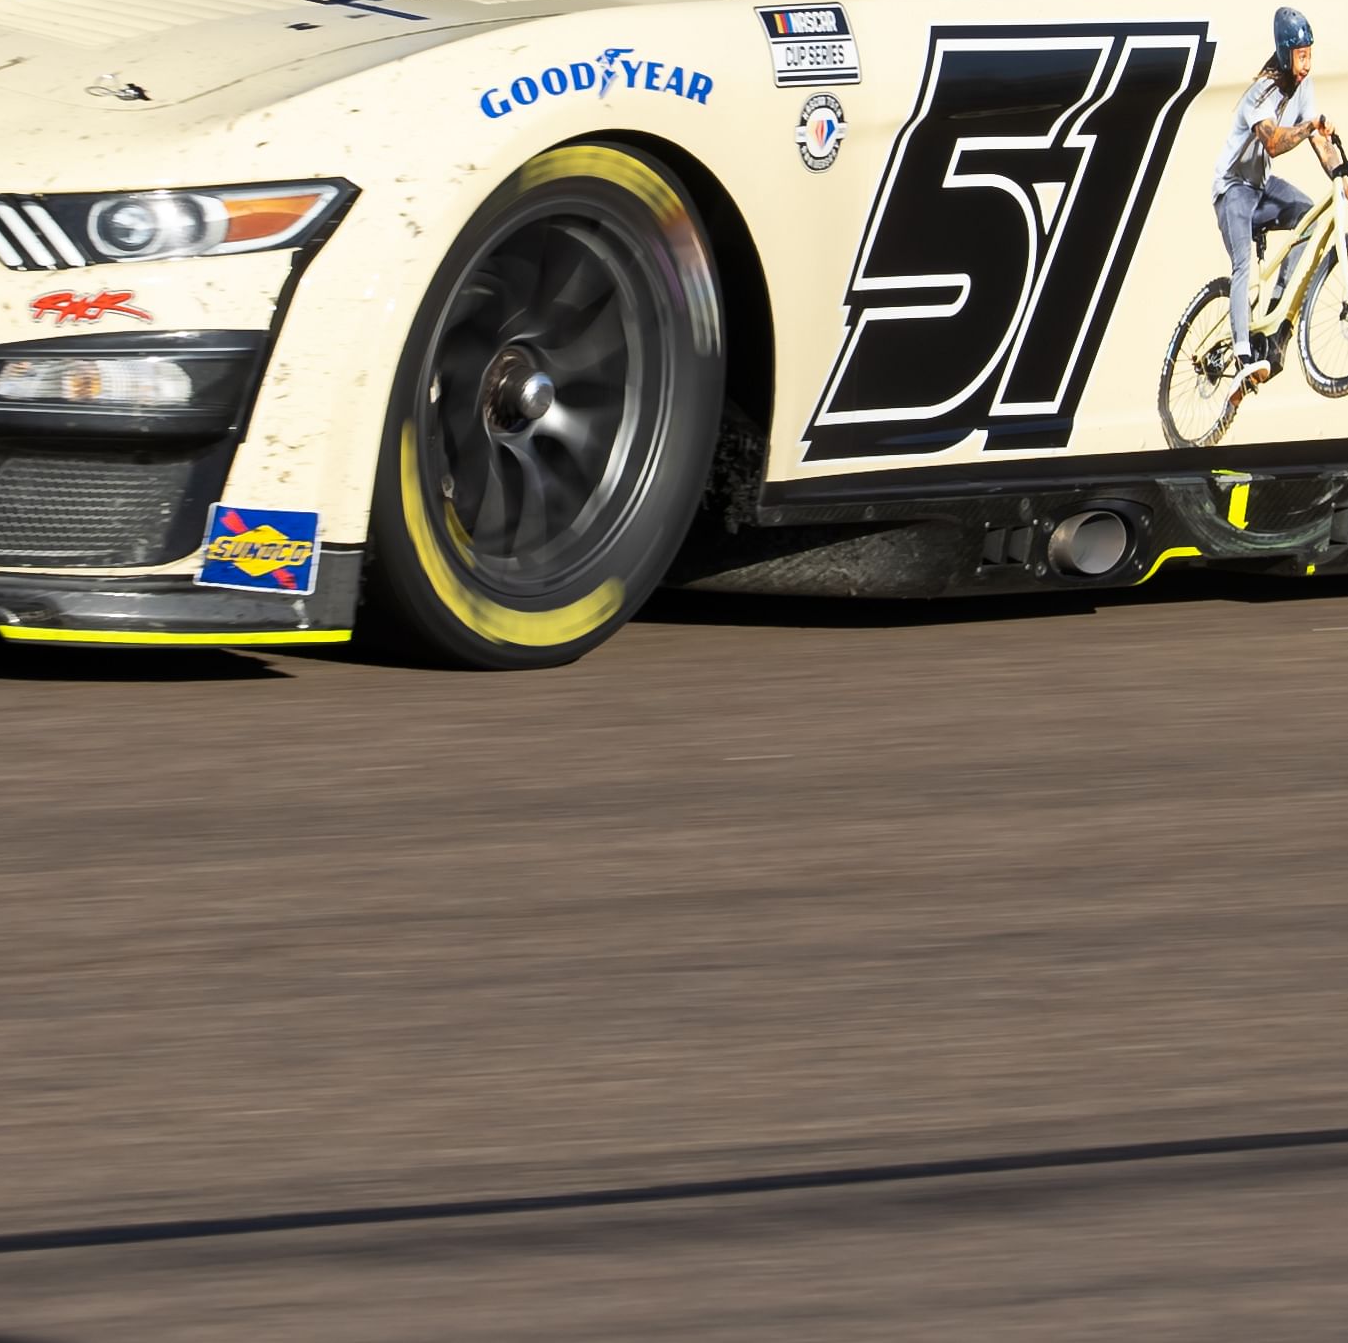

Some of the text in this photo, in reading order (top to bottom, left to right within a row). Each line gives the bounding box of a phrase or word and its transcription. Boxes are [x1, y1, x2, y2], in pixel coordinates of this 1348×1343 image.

[790, 11, 838, 34] NASCAR
[786, 44, 845, 66] CUP SERIES
[801, 20, 1217, 464] 51
[207, 538, 313, 563] SUNOCO
